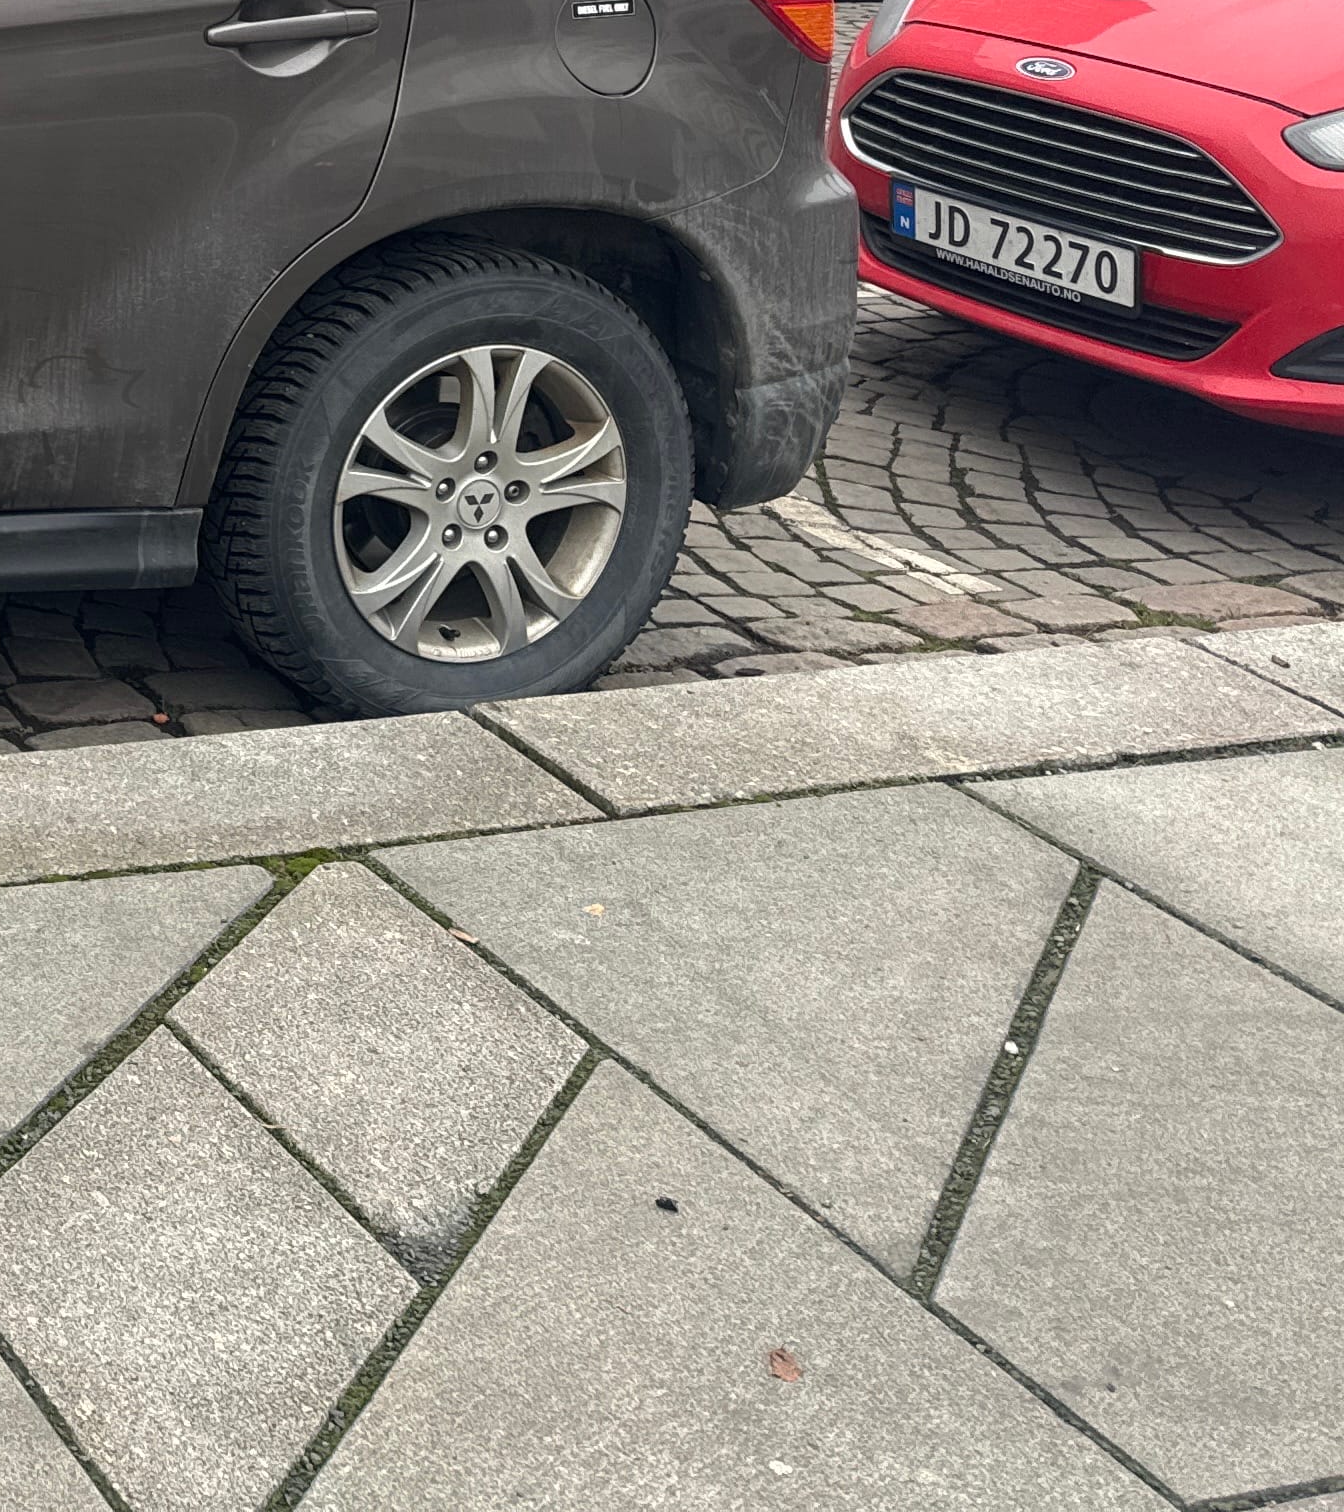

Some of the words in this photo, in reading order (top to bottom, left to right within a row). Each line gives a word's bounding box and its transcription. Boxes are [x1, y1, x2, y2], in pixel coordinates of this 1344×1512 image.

[1026, 61, 1062, 76] Ford
[899, 215, 910, 230] N
[928, 200, 971, 248] JD
[989, 217, 1119, 295] 72270
[935, 247, 1082, 304] WWW.HARALDSENAUTO.NO
